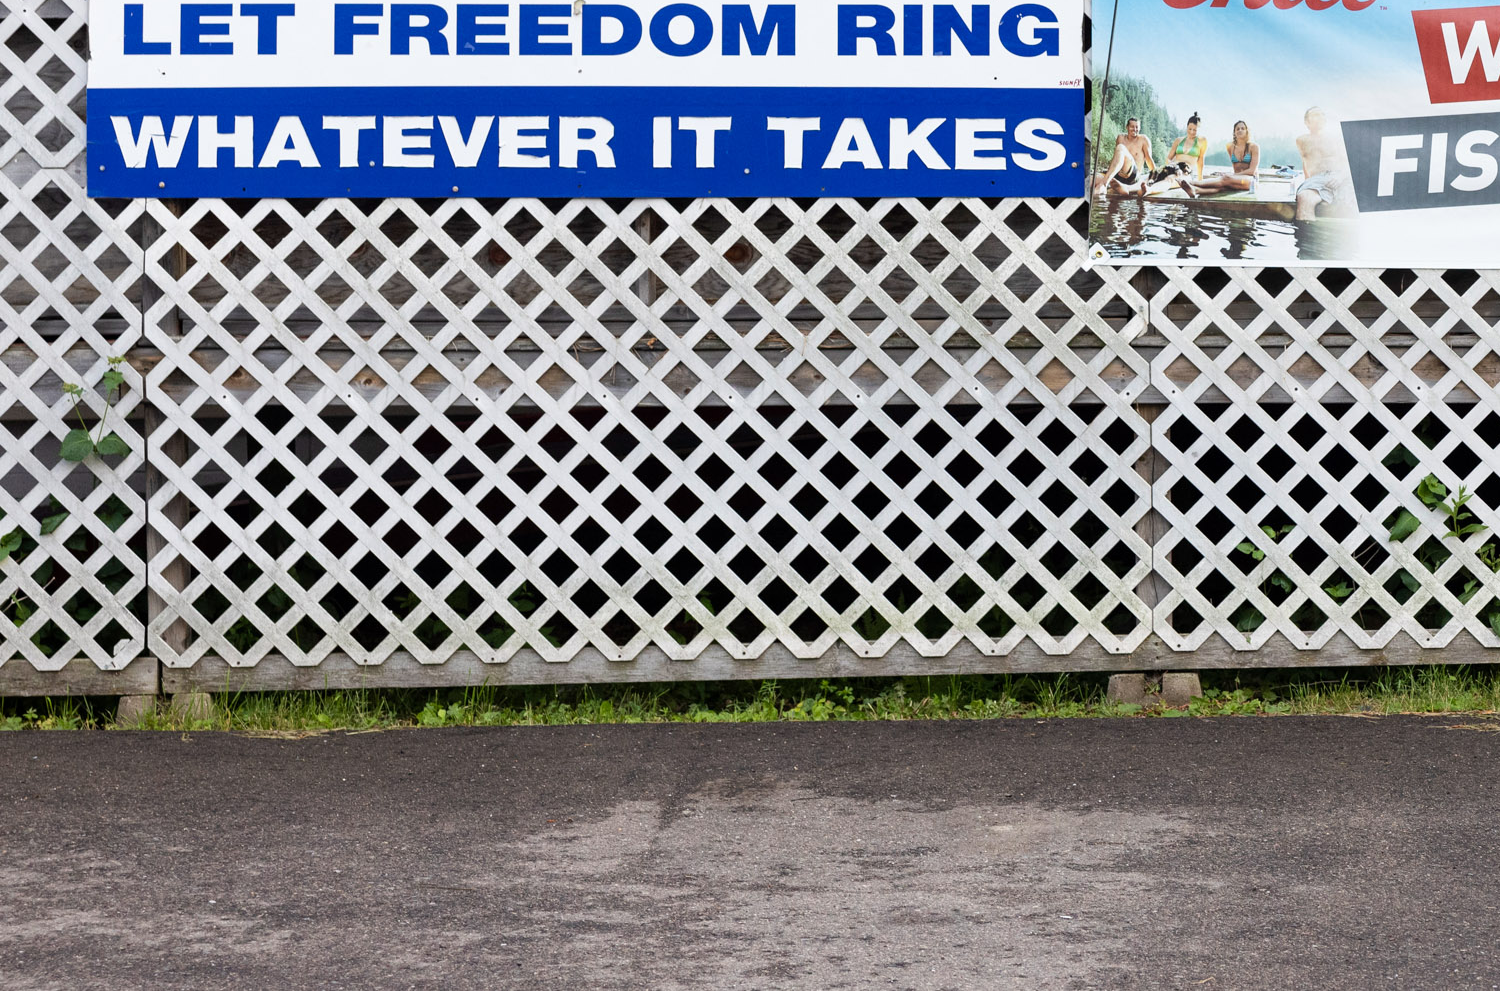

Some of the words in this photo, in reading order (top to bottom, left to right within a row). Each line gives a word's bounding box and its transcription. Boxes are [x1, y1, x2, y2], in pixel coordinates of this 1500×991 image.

[123, 3, 296, 56] LET
[333, 2, 796, 57] FREEDOM
[837, 3, 1060, 58] RING
[110, 115, 616, 169] WHATEVER
[652, 116, 732, 169] IT
[767, 116, 1066, 172] TAKES
